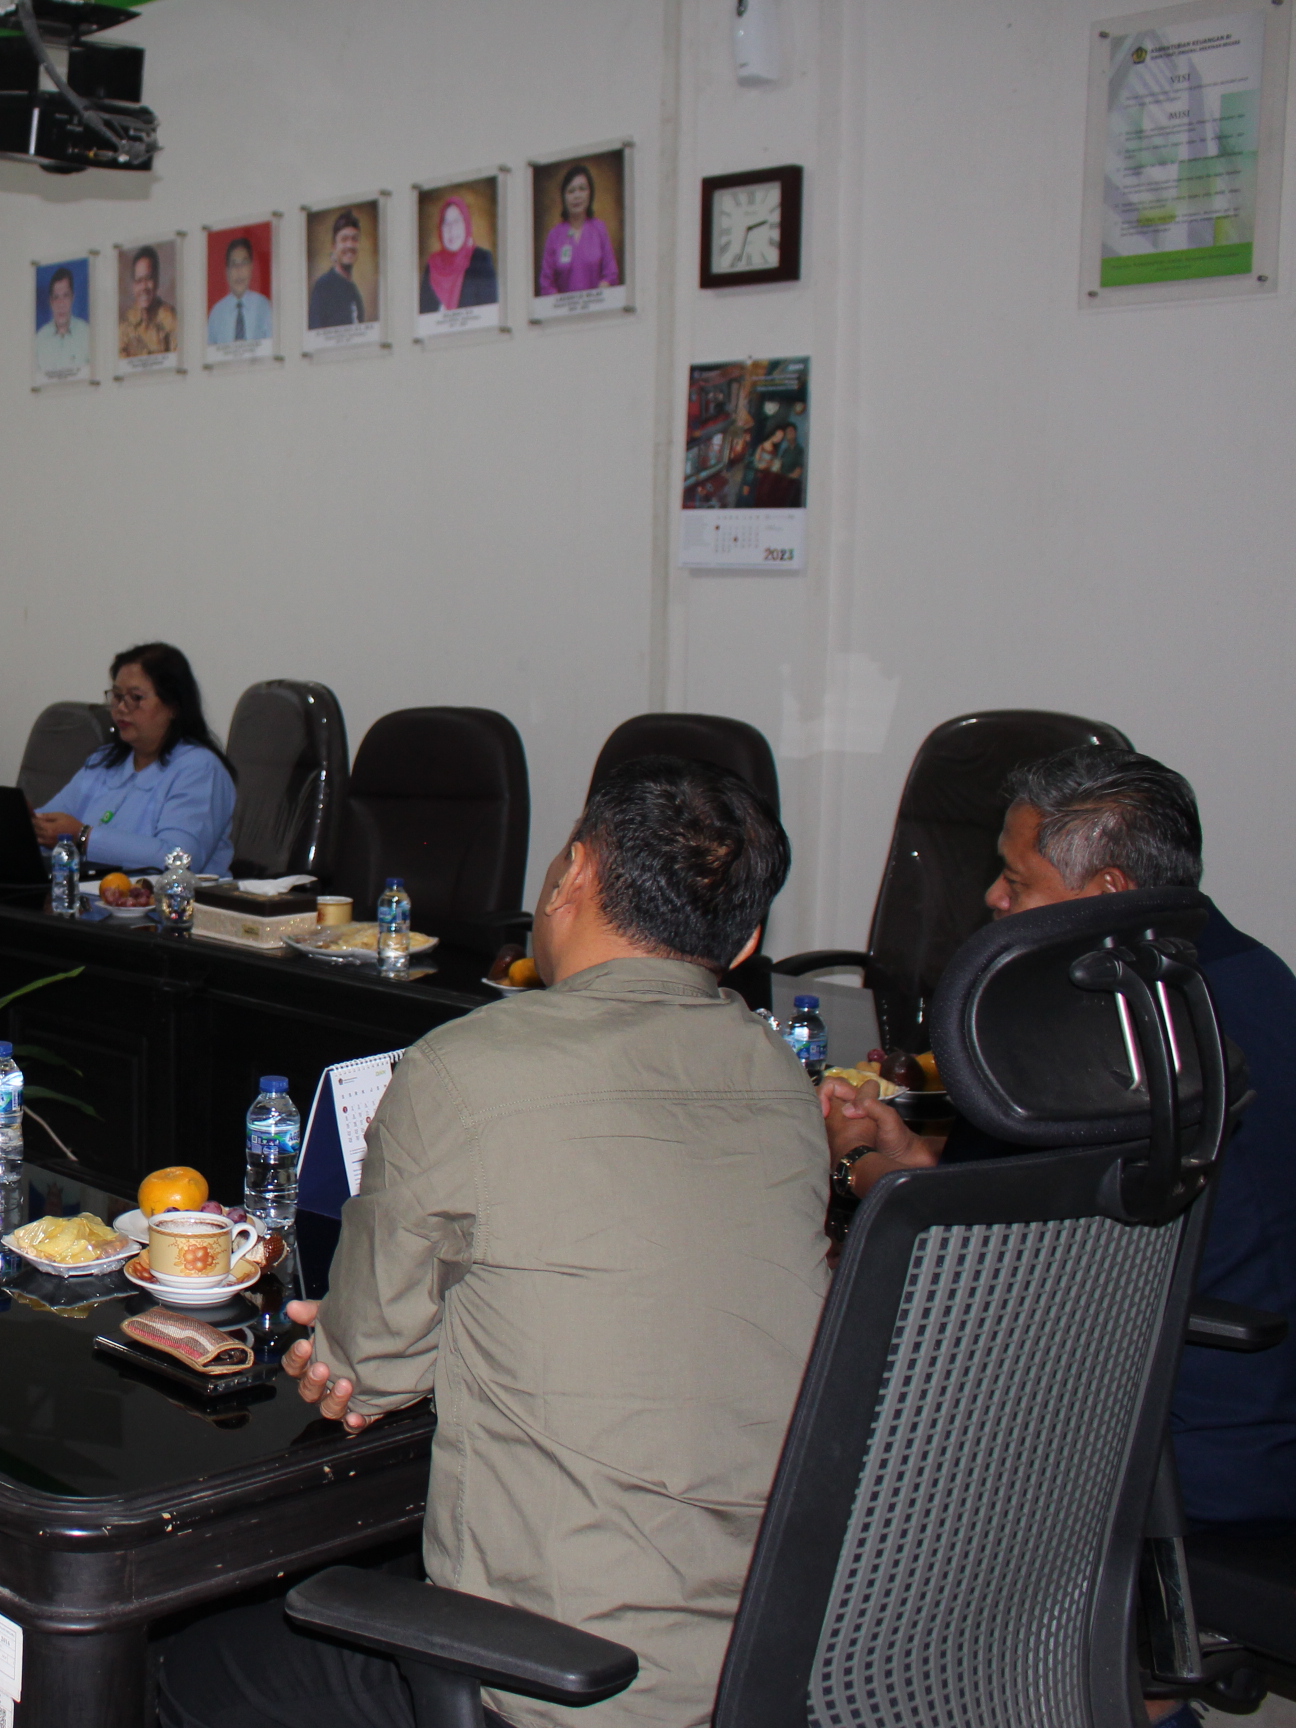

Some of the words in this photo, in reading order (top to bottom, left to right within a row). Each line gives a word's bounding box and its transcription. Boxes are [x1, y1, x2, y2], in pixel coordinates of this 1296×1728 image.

[1170, 73, 1191, 84] VISI
[1169, 110, 1191, 120] MISI
[764, 547, 795, 561] 2023
